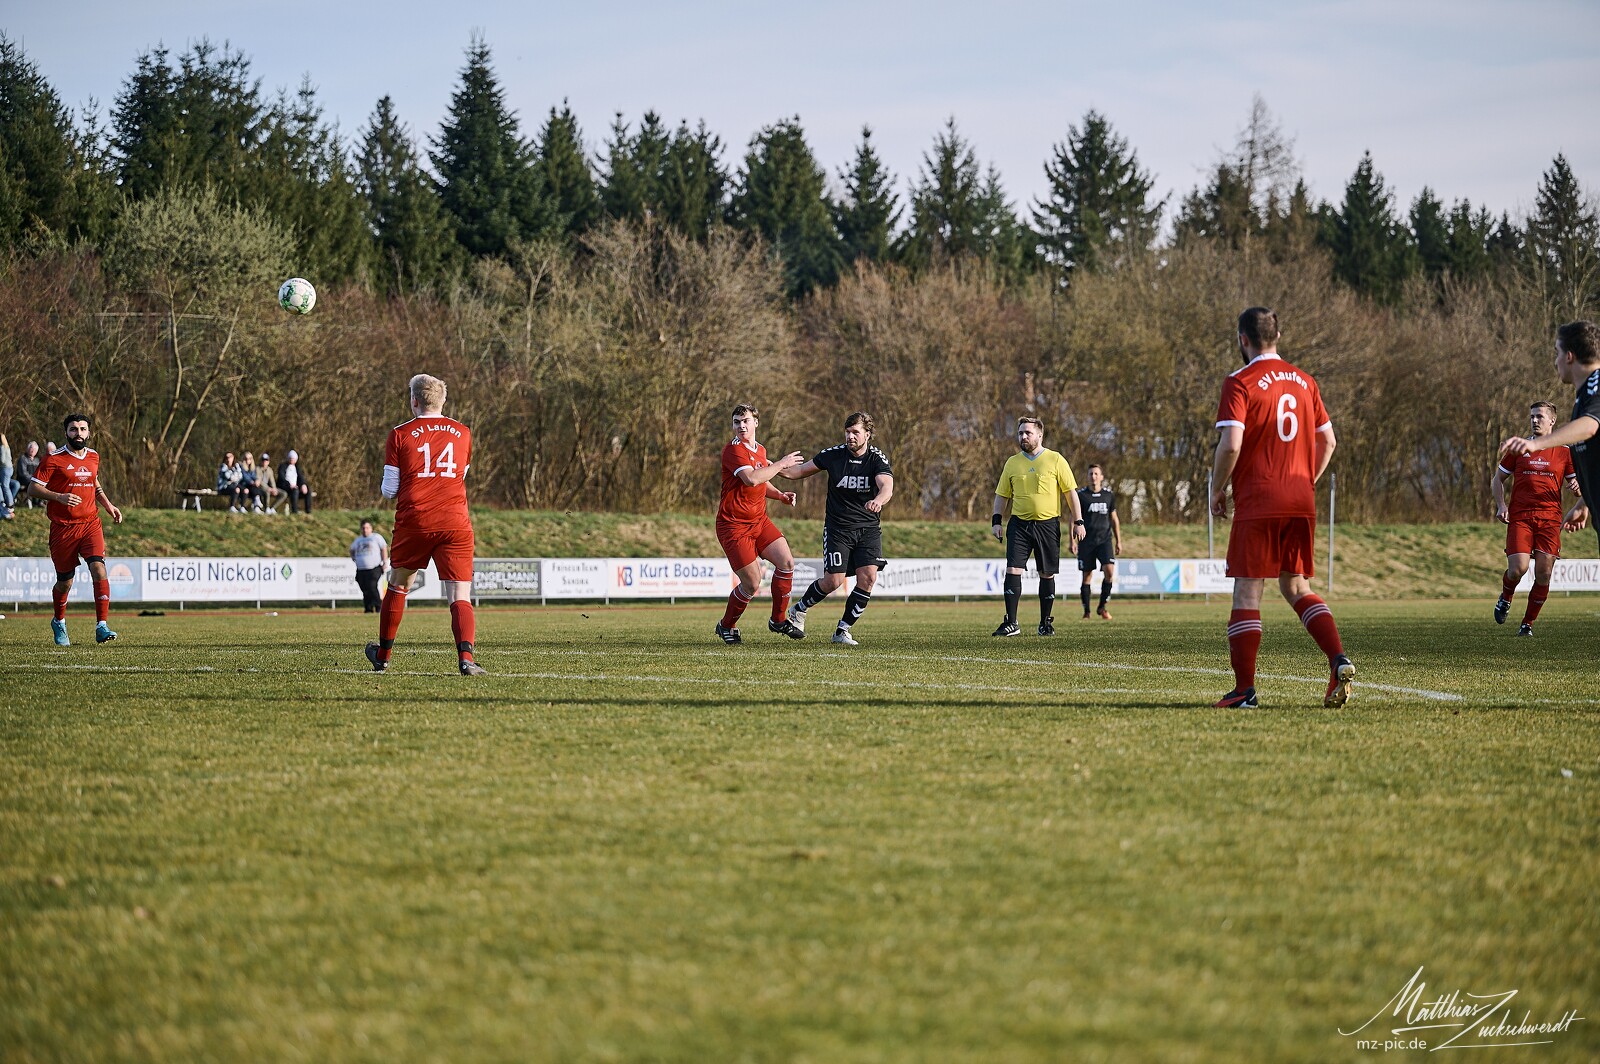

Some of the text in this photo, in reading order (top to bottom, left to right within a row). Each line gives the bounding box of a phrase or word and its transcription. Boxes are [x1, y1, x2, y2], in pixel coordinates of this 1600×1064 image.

[1258, 371, 1308, 390] SV Laufen
[1277, 393, 1298, 442] 6
[411, 424, 462, 438] SV Laufen
[417, 442, 457, 478] 14
[836, 475, 870, 489] ABEL
[828, 551, 843, 567] 10
[147, 561, 276, 581] Heizöl Nickolai
[639, 564, 668, 578] Kurt
[674, 563, 714, 578] Bobaz
[305, 572, 356, 585] Braunsperg
[0, 587, 23, 598] eizung
